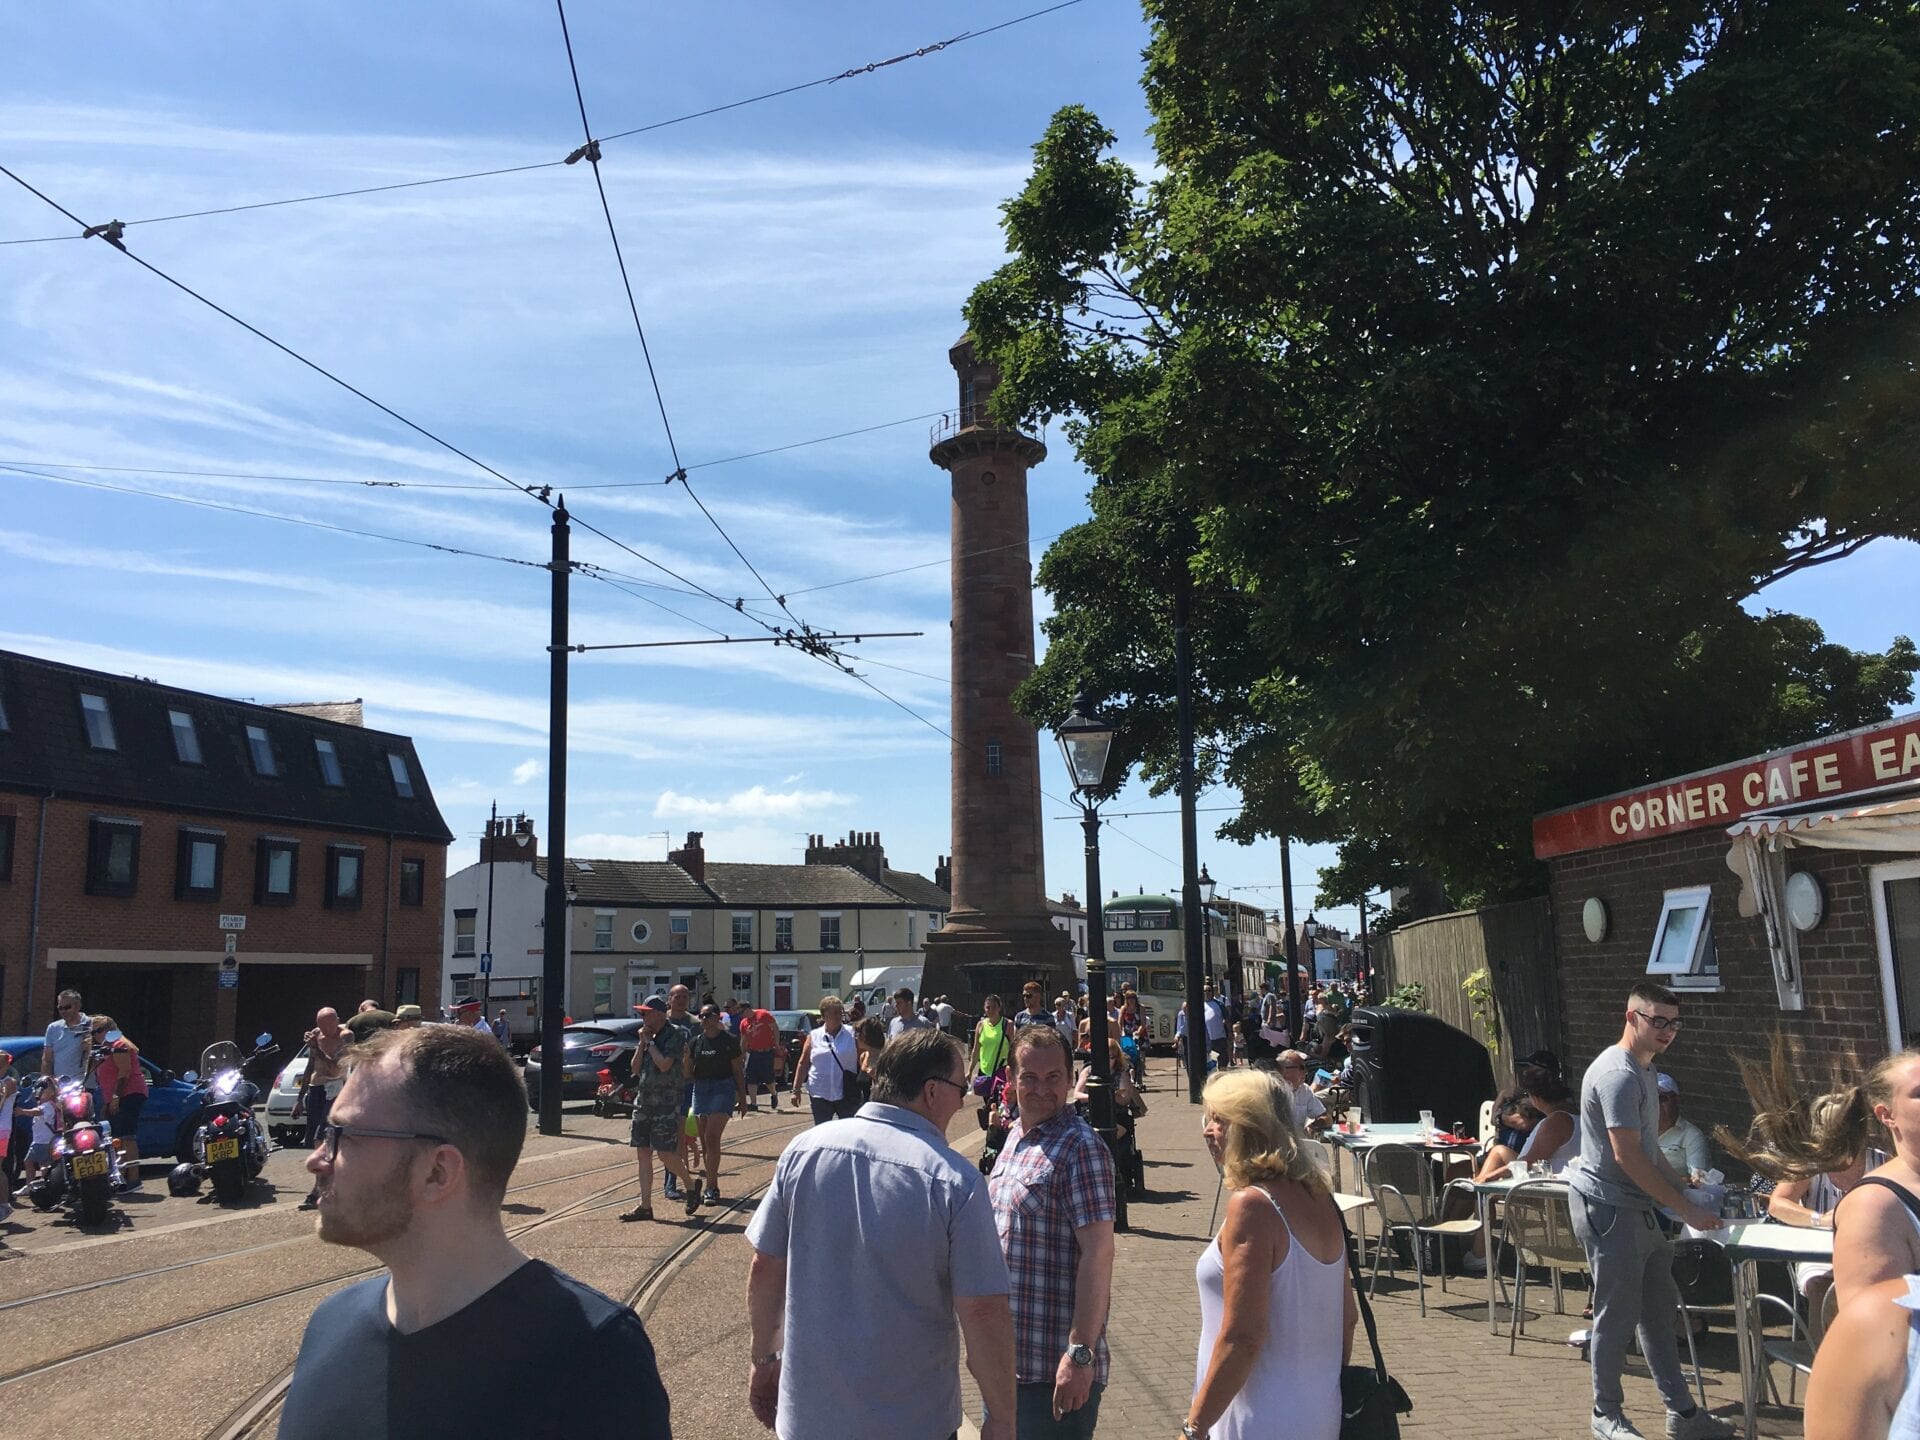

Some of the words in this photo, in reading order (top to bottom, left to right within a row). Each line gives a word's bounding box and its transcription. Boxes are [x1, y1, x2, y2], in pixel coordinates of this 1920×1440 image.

[1609, 782, 1729, 836] CORNER
[1742, 752, 1842, 807] CAFE
[1869, 732, 1920, 781] EA
[1153, 941, 1162, 950] 14
[76, 1153, 103, 1168] PK12
